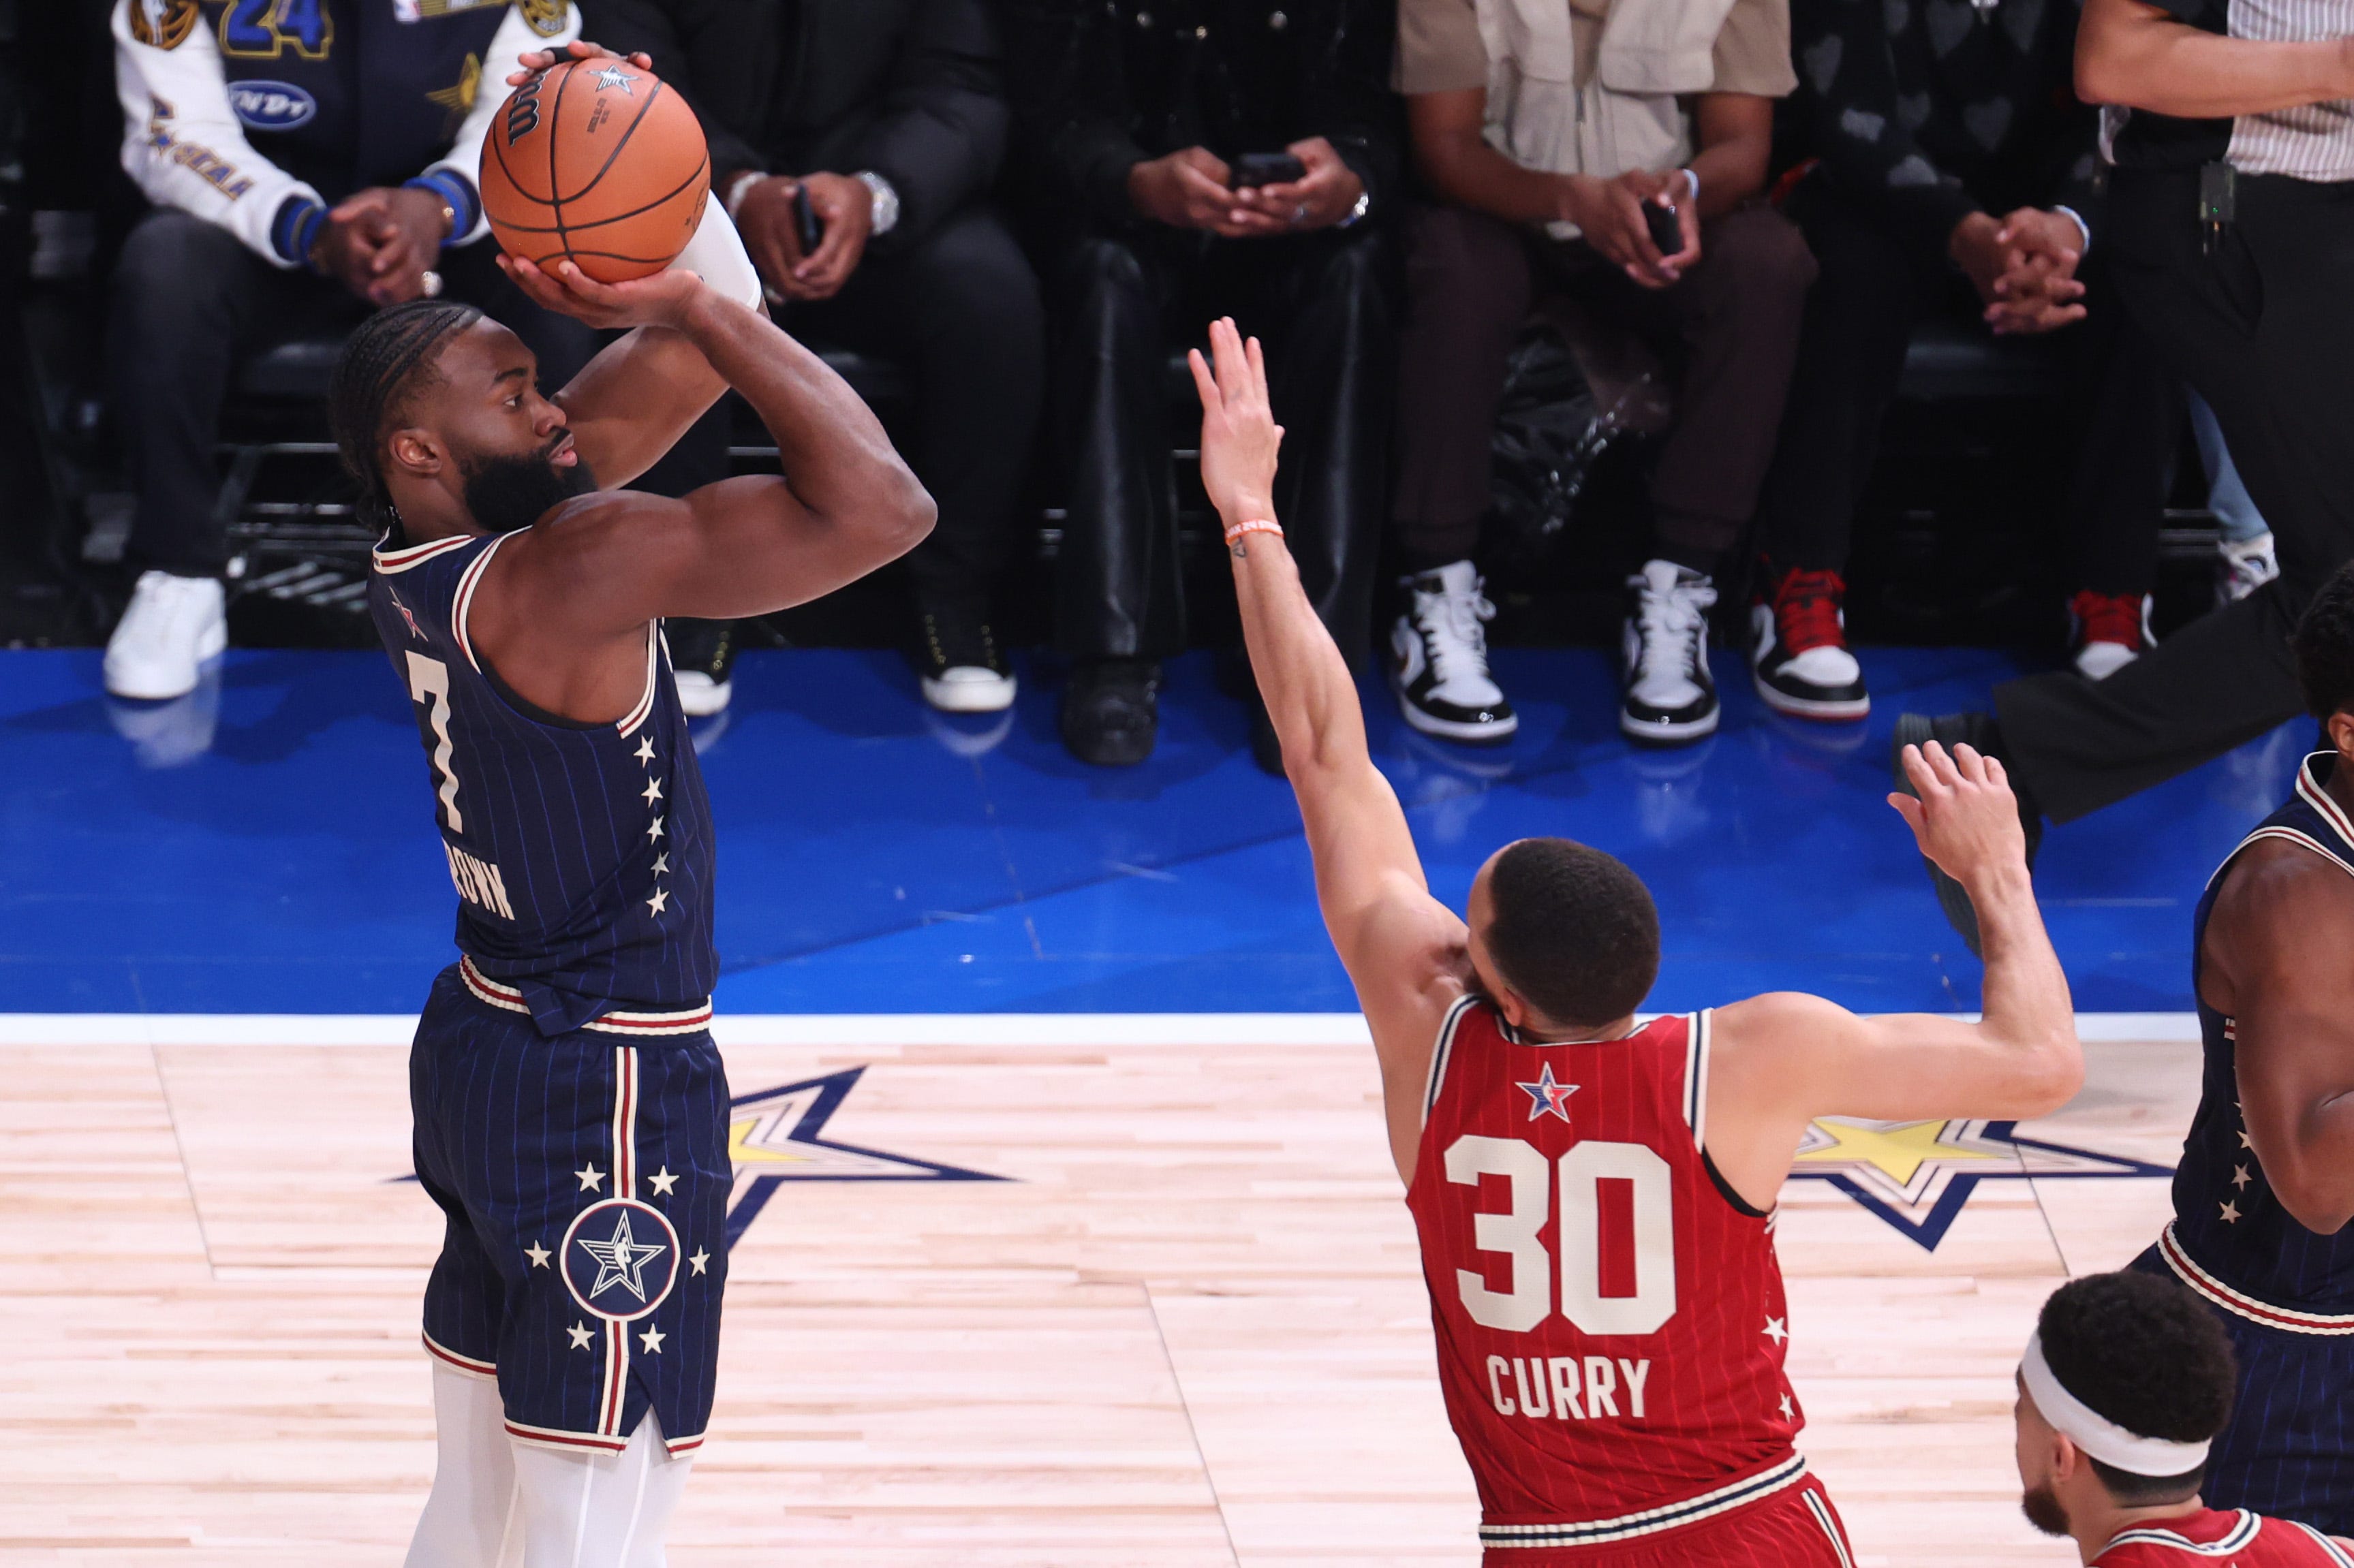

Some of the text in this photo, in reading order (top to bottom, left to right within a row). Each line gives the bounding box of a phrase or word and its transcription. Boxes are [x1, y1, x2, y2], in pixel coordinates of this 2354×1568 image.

[405, 649, 463, 834] 7
[441, 836, 516, 921] ROWN
[1444, 1134, 1677, 1336] 30
[1486, 1354, 1650, 1420] CURRY
